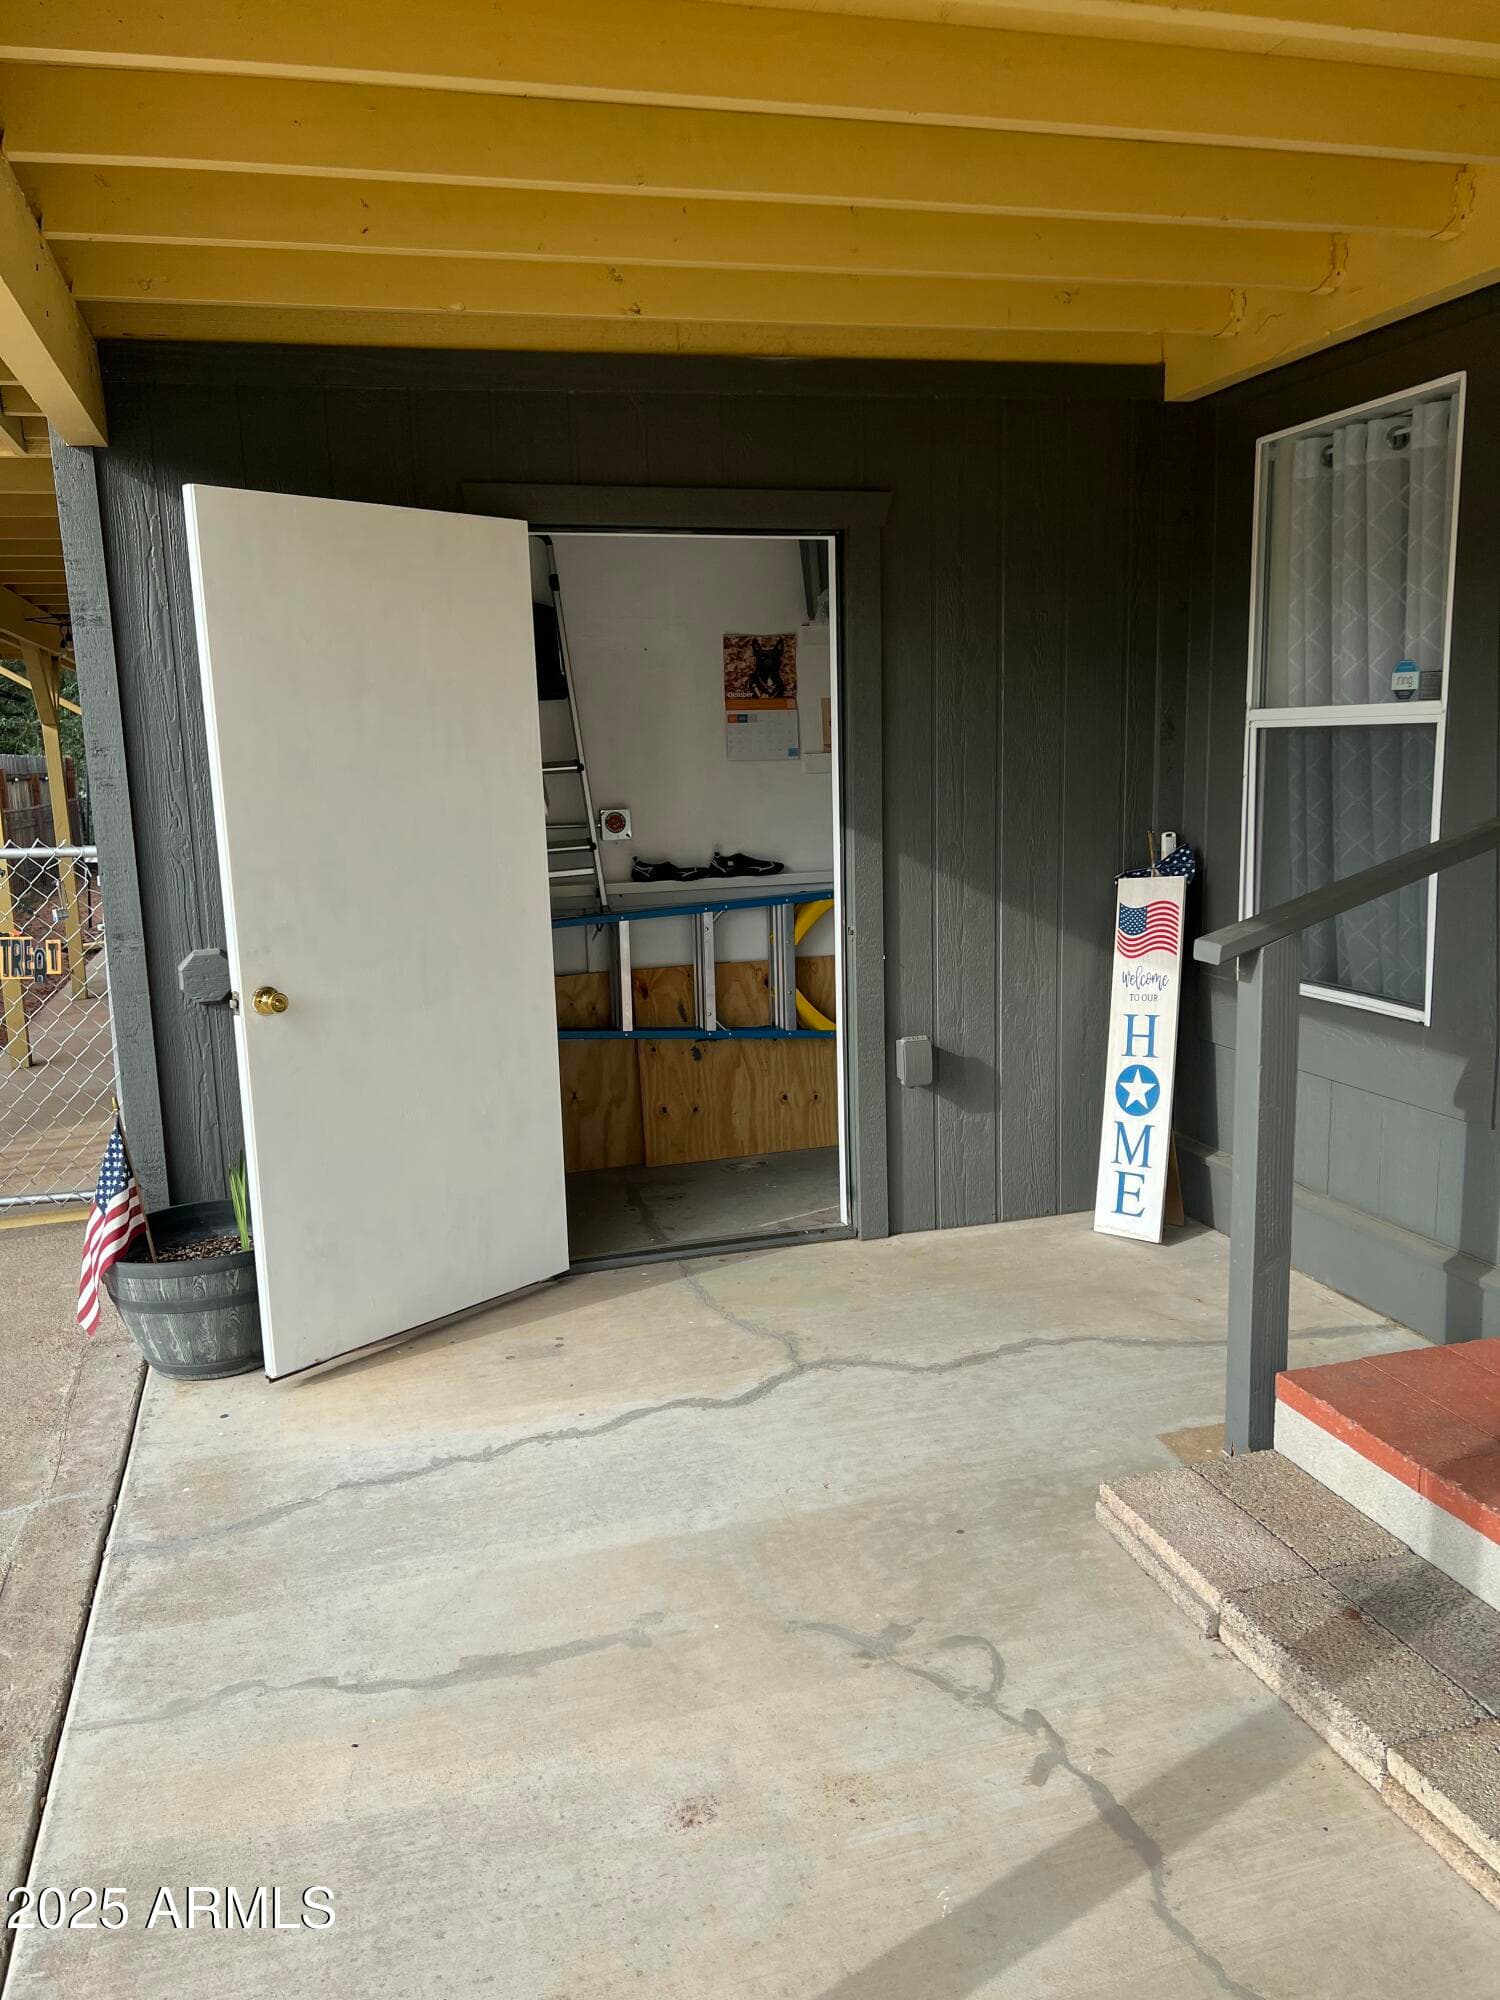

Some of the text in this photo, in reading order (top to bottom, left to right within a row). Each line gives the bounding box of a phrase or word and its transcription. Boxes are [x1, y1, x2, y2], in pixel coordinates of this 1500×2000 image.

[727, 690, 754, 698] October
[0, 939, 58, 984] TREAT
[1122, 965, 1169, 991] welcome
[1129, 993, 1159, 1002] TO OUR
